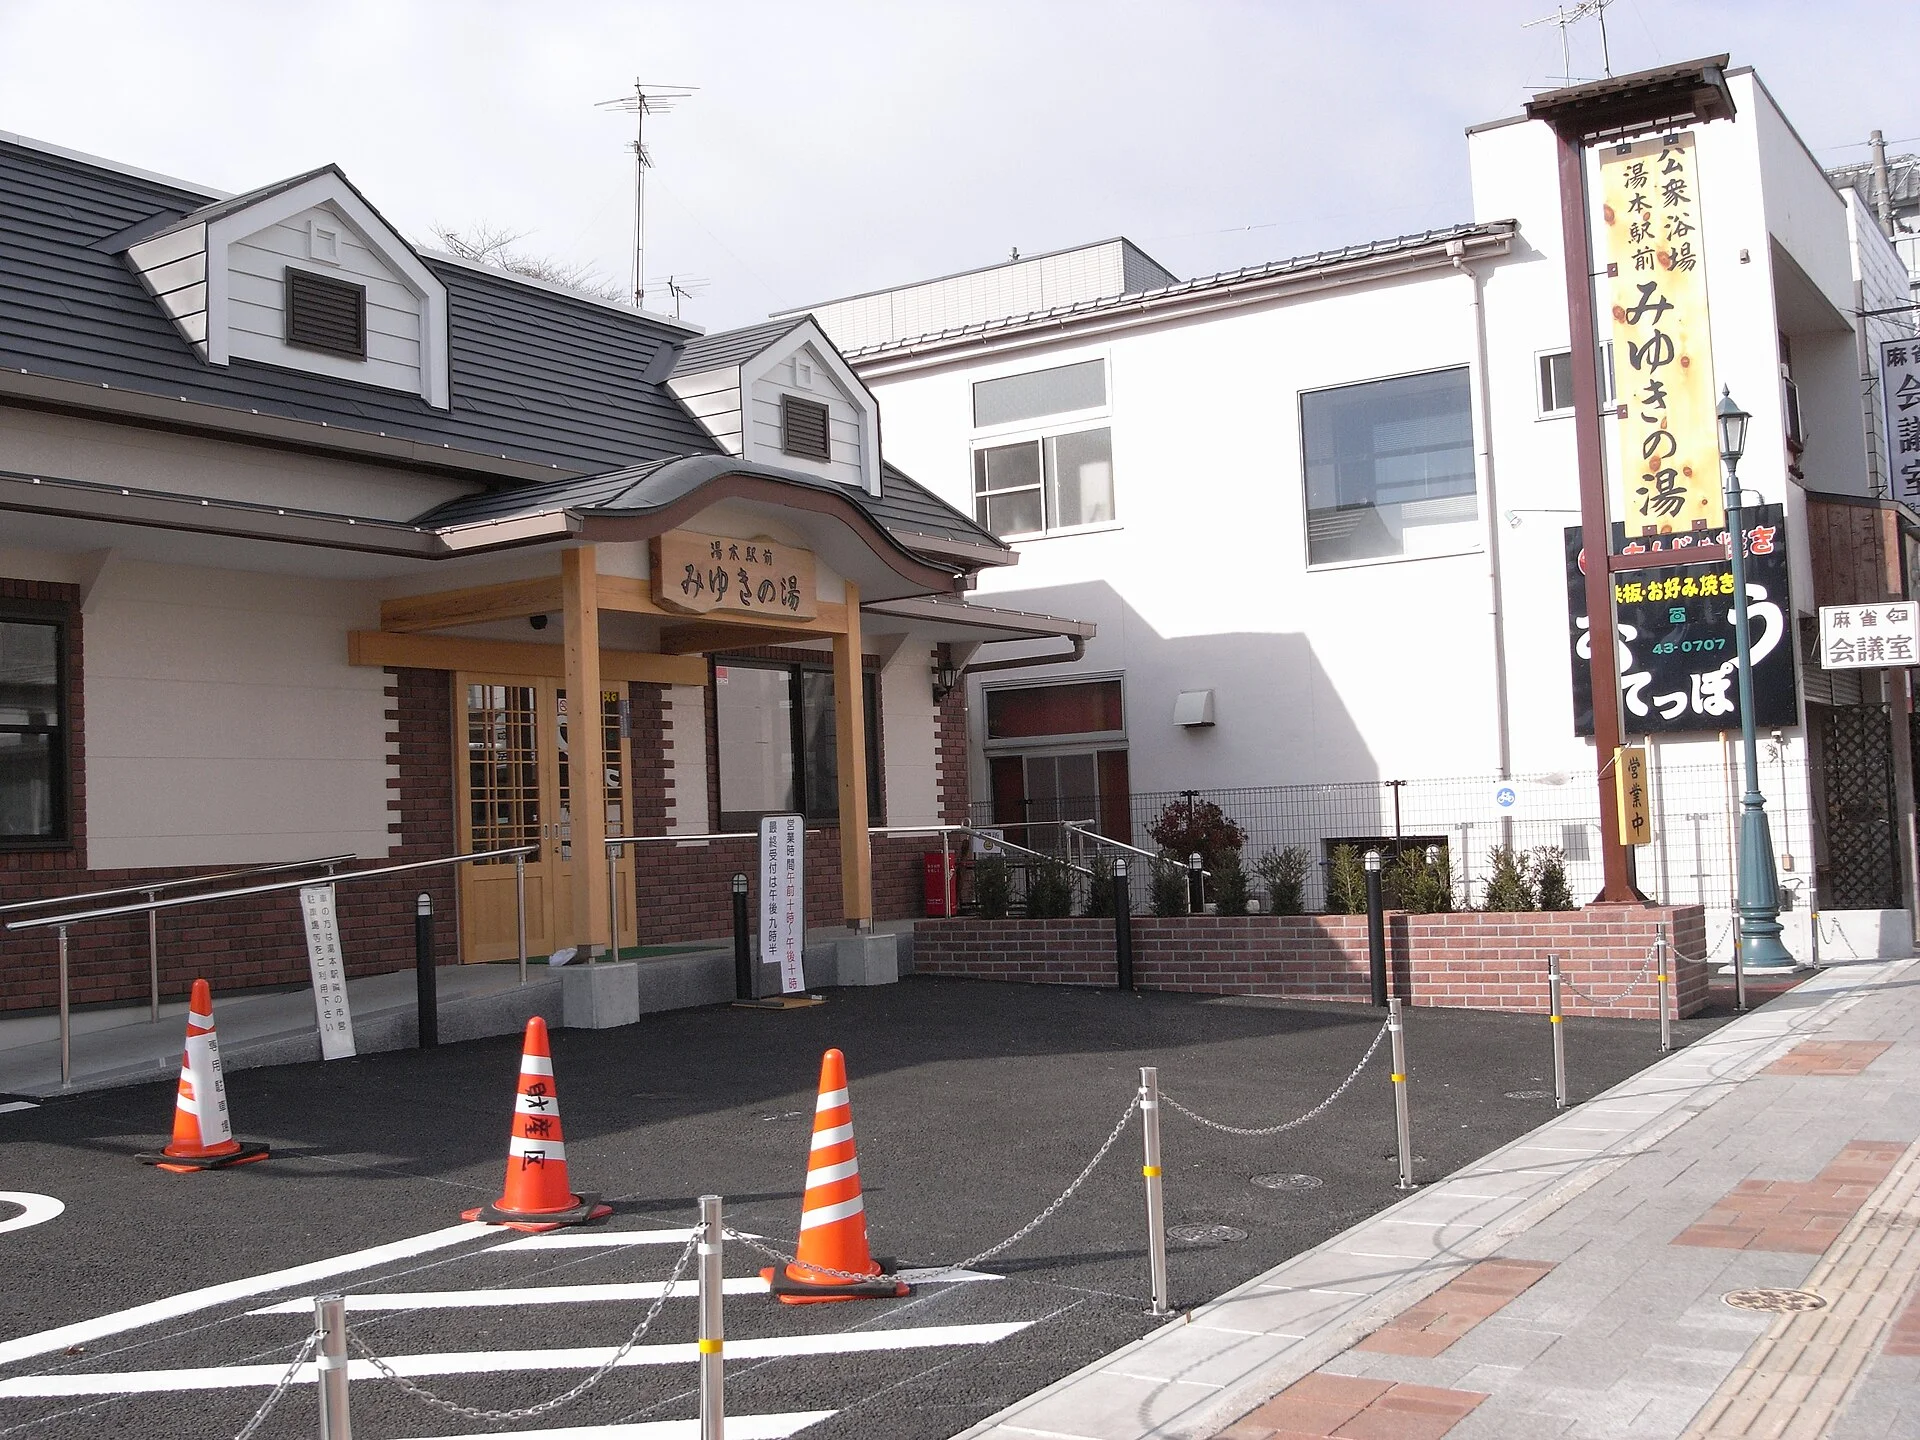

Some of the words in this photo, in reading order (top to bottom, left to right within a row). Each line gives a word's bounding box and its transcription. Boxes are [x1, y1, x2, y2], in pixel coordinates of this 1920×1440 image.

[1623, 164, 1655, 271] 湯本駅前
[1656, 146, 1697, 273] 公衆浴場
[1626, 281, 1688, 519] みゆきの湯
[709, 540, 773, 566] 湯本駅前
[680, 563, 801, 611] みゆきの湯
[1652, 638, 1726, 654] 43-0707
[1829, 635, 1913, 663] 会議室
[1832, 610, 1878, 628] 麻雀
[1627, 758, 1645, 837] 営業中
[768, 820, 778, 956] 最終受付は午後九時半
